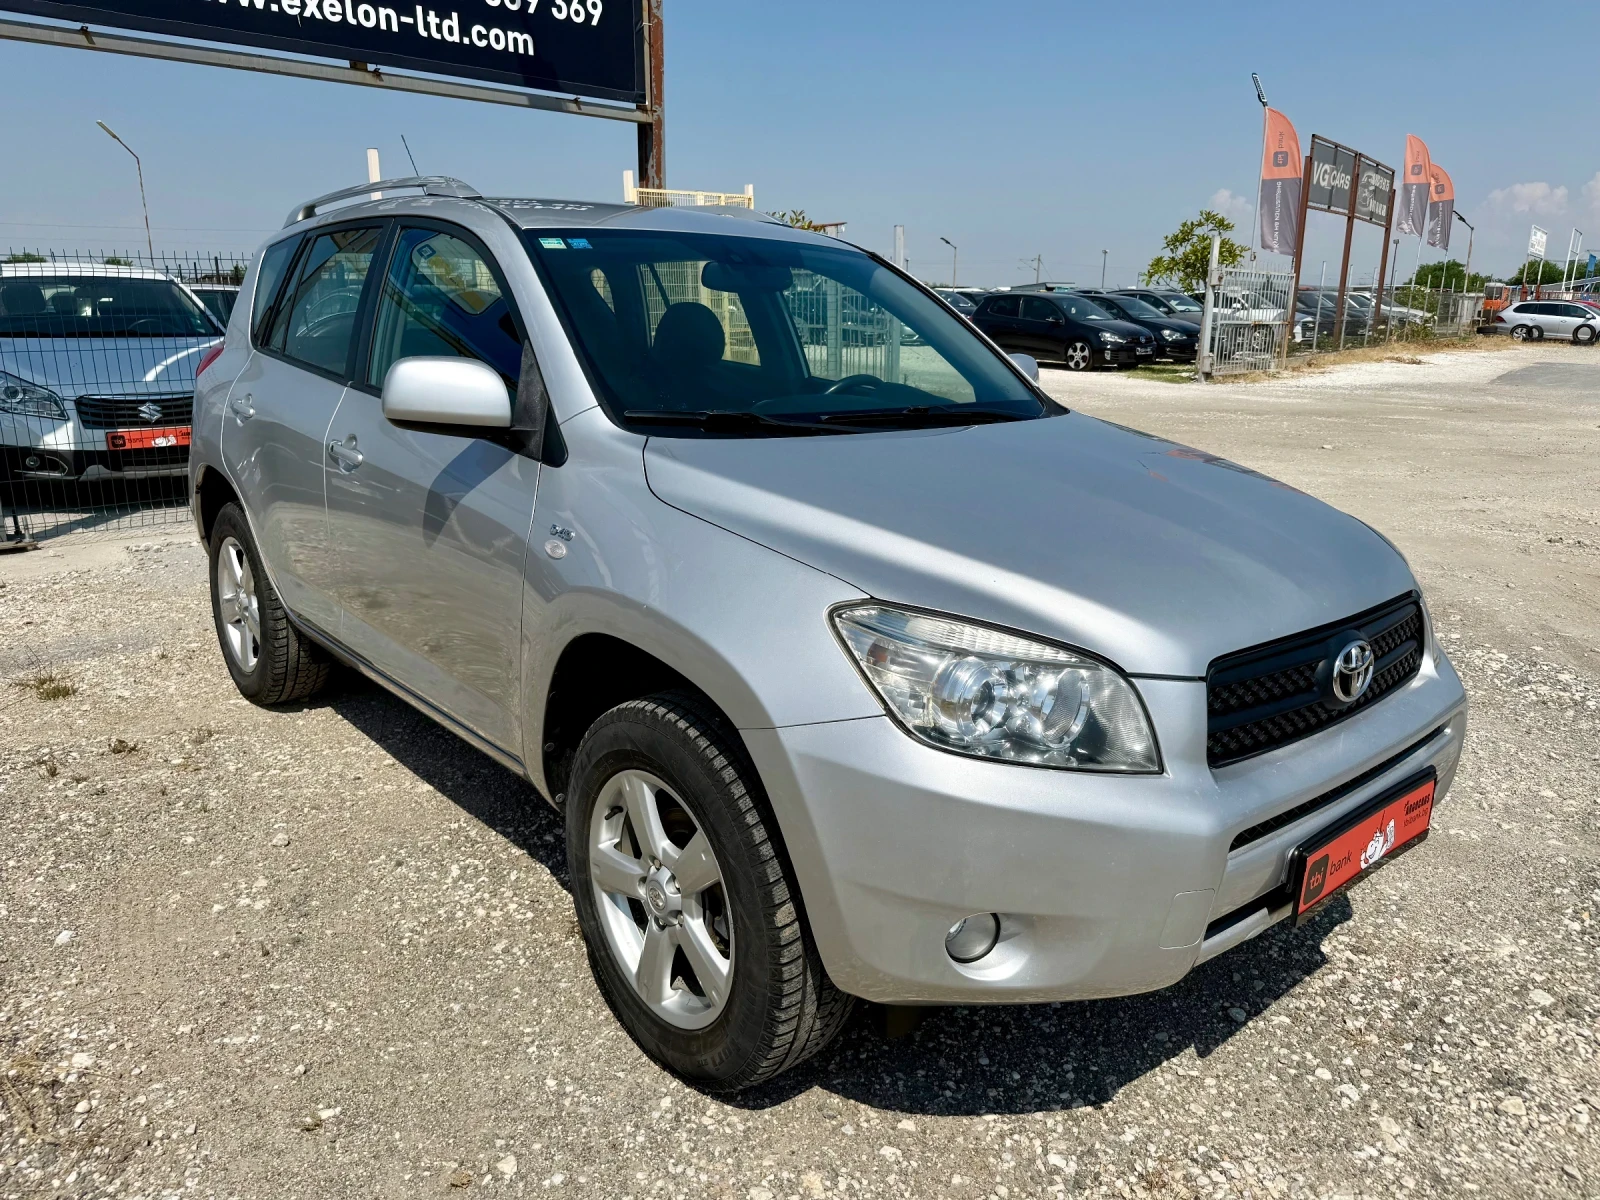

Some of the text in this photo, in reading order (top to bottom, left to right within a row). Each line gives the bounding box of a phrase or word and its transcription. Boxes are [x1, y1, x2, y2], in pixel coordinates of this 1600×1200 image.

[204, 0, 534, 56] .exelon-ltd.com
[1313, 160, 1330, 187] VG
[1330, 169, 1351, 190] CARS
[1309, 849, 1353, 890] tbi bank
